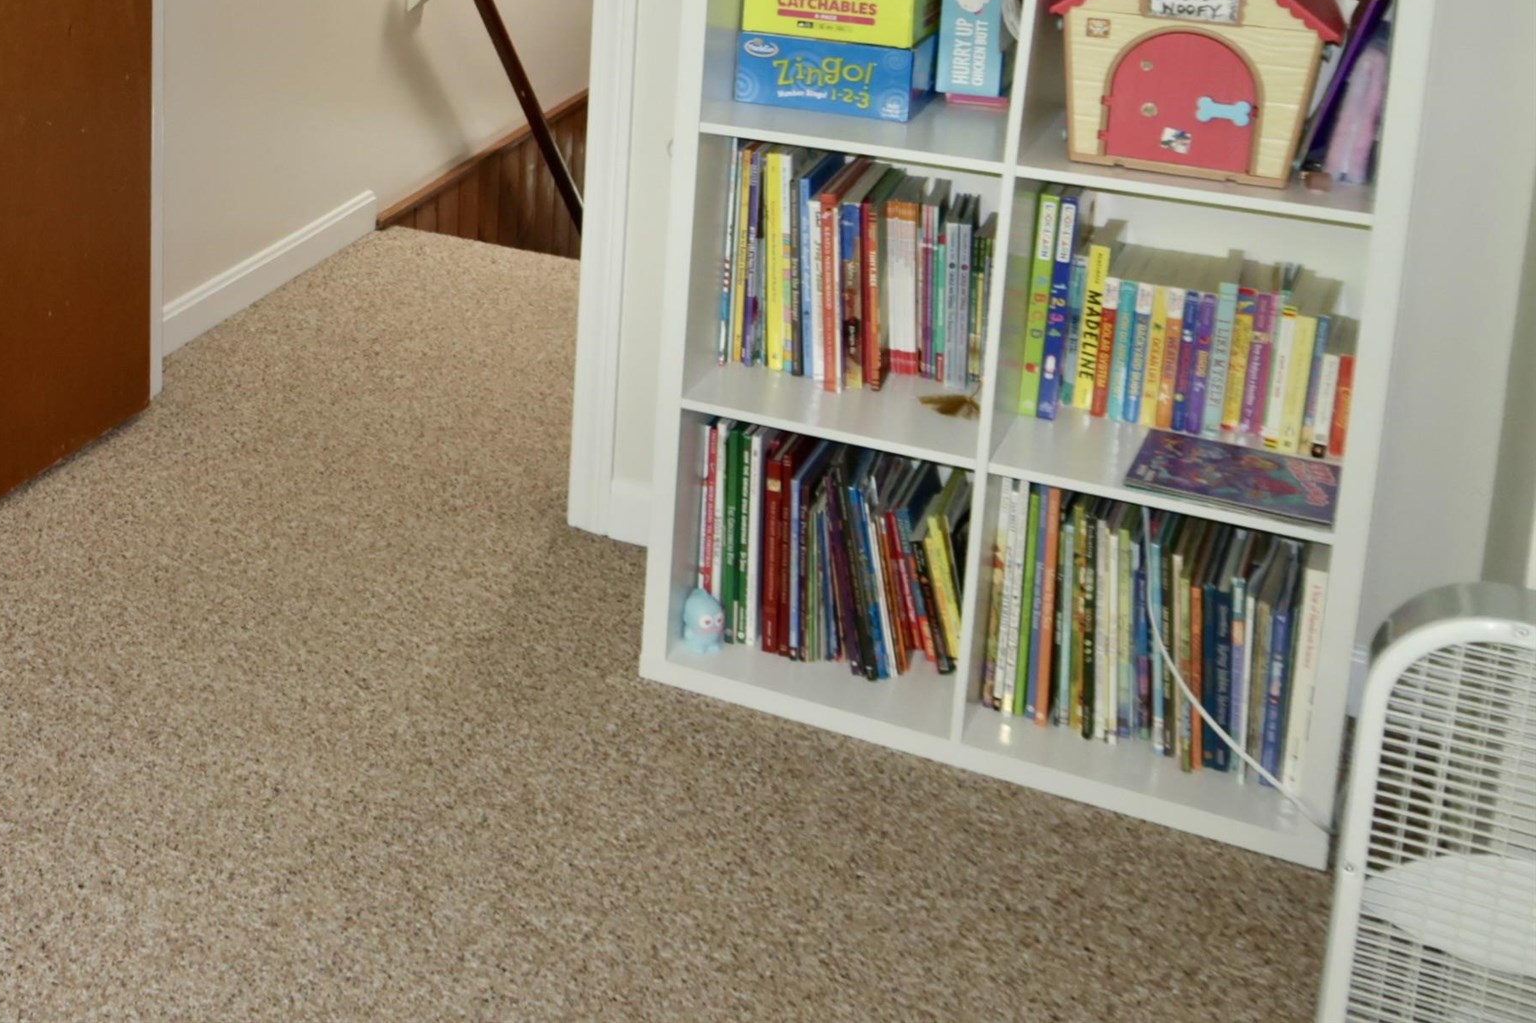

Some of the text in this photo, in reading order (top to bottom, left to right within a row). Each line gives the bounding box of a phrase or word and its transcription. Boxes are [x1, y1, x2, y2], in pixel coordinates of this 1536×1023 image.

[772, 56, 875, 90] Zingo!
[951, 17, 974, 85] HURRY UP
[971, 20, 989, 87] CHICKEN BUTT
[830, 87, 871, 109] 1-2-3
[1030, 328, 1043, 339] D
[1048, 328, 1062, 338] 4
[1078, 290, 1103, 381] MADELINE
[1097, 322, 1113, 388] SOLAR SYSTEM
[1133, 324, 1147, 371] BACKYARD
[1216, 328, 1230, 353] LIKE
[1148, 337, 1163, 384] OCEAN LIFE
[1165, 335, 1177, 380] WEATHER
